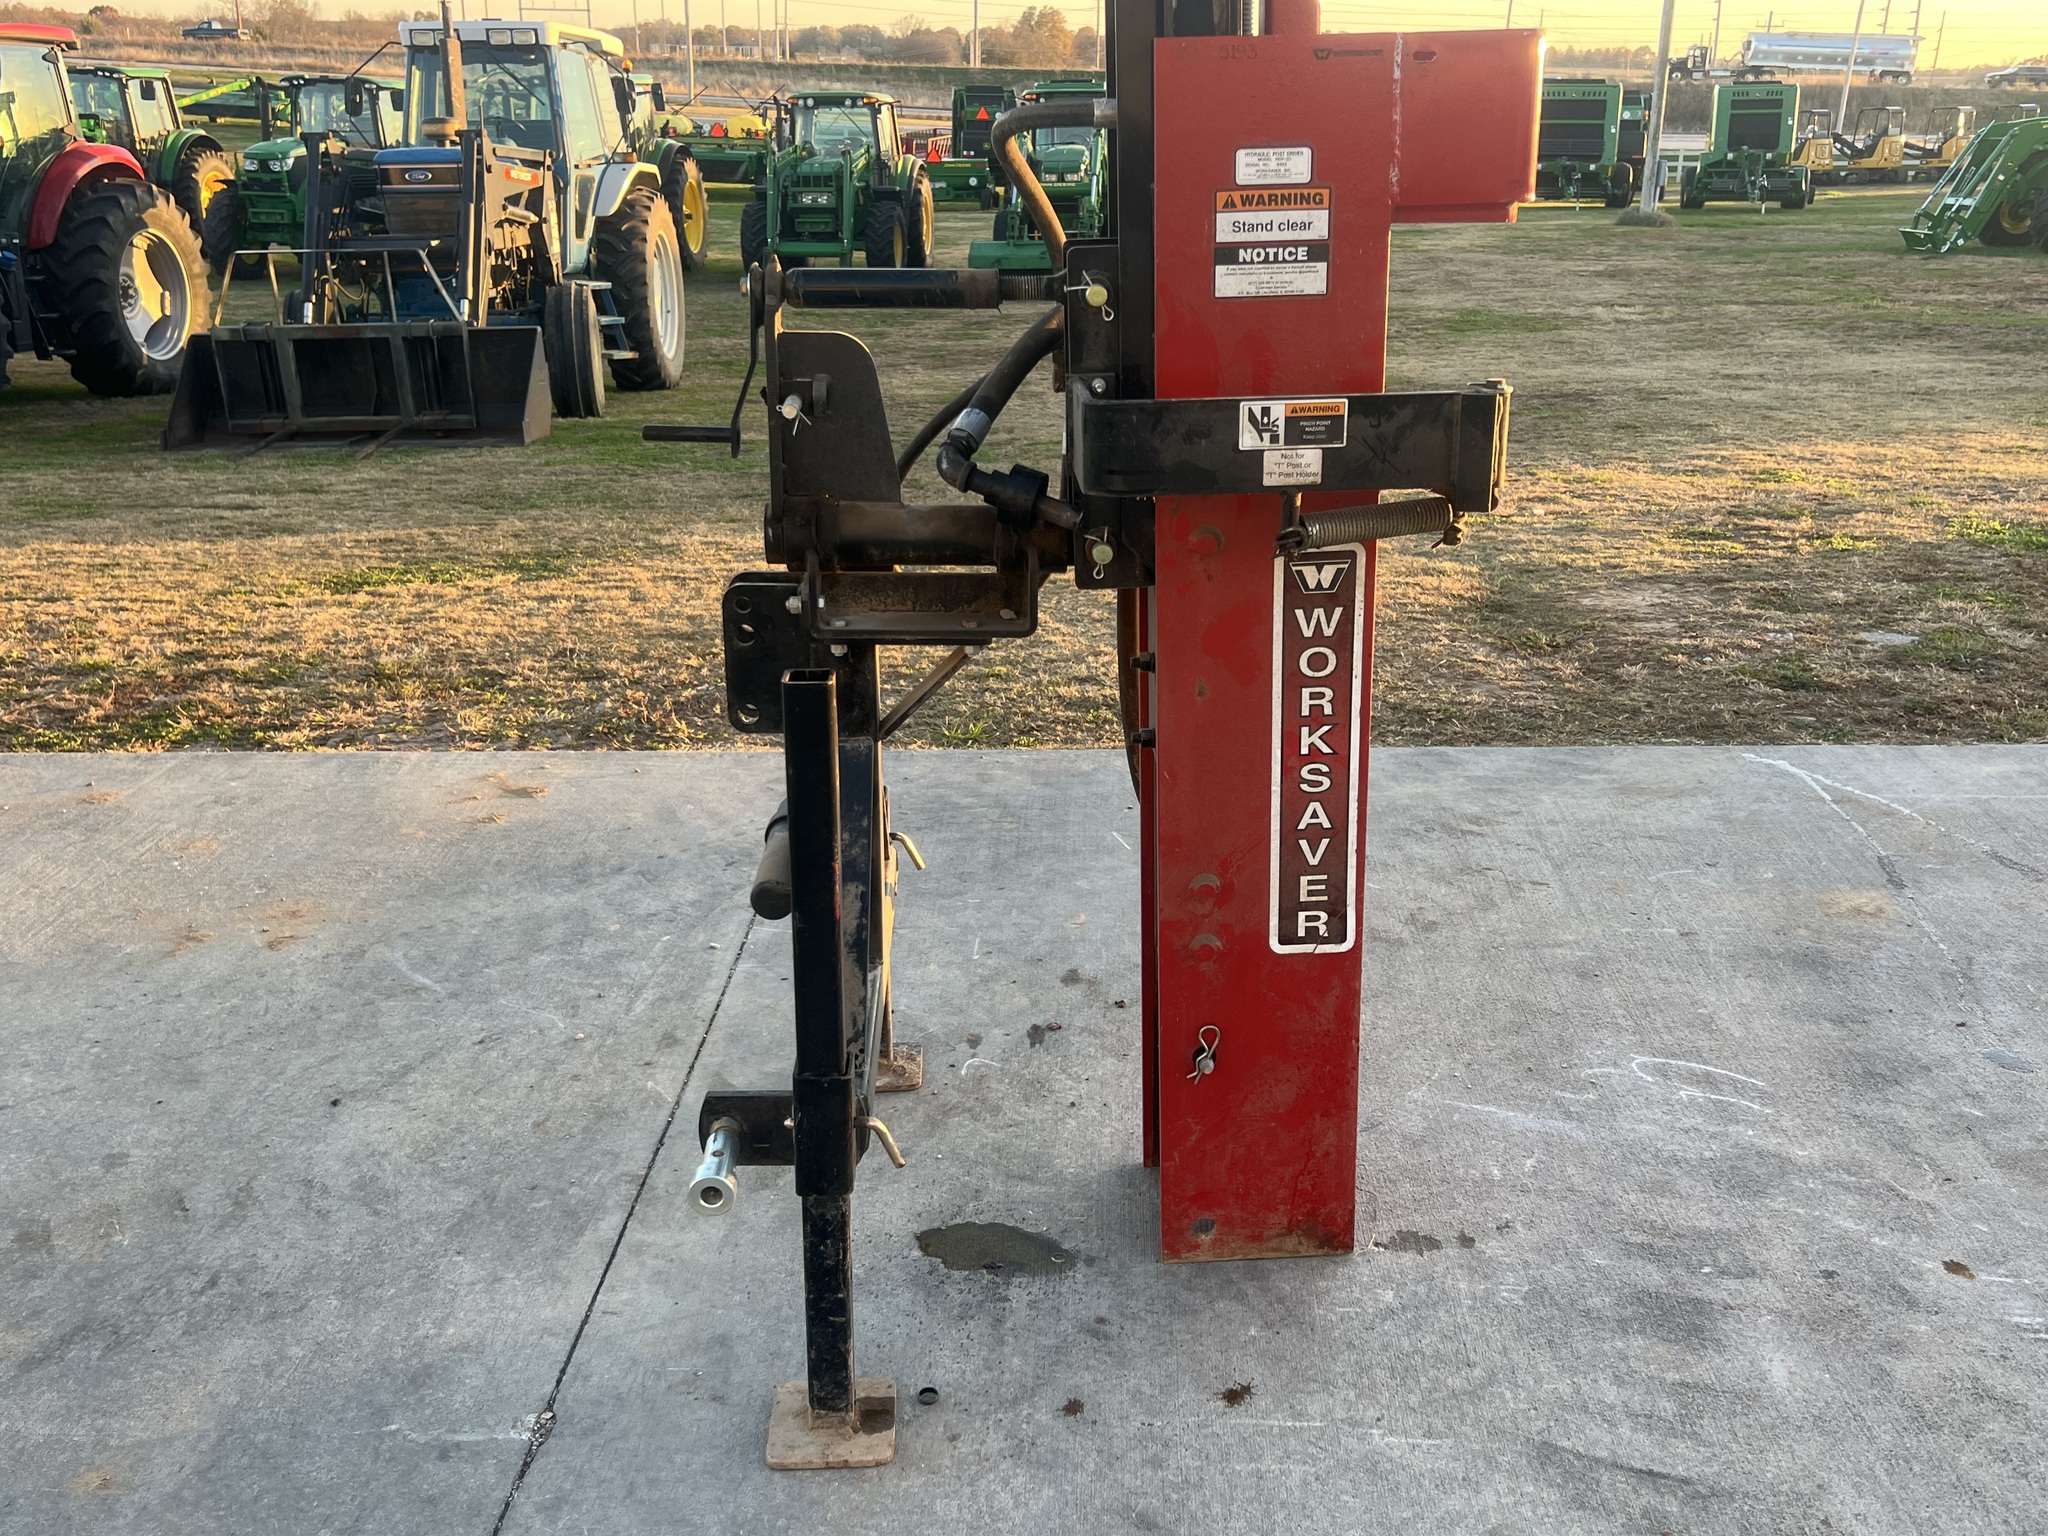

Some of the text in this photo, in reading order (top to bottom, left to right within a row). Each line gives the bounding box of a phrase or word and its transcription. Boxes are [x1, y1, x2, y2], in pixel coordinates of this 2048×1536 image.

[1240, 192, 1324, 208] WARNING
[1232, 219, 1313, 233] Stand clear
[1238, 246, 1308, 263] NOTICE
[1298, 405, 1340, 414] WARNING
[1296, 452, 1305, 460] for
[1294, 607, 1343, 938] WORKSAVER
